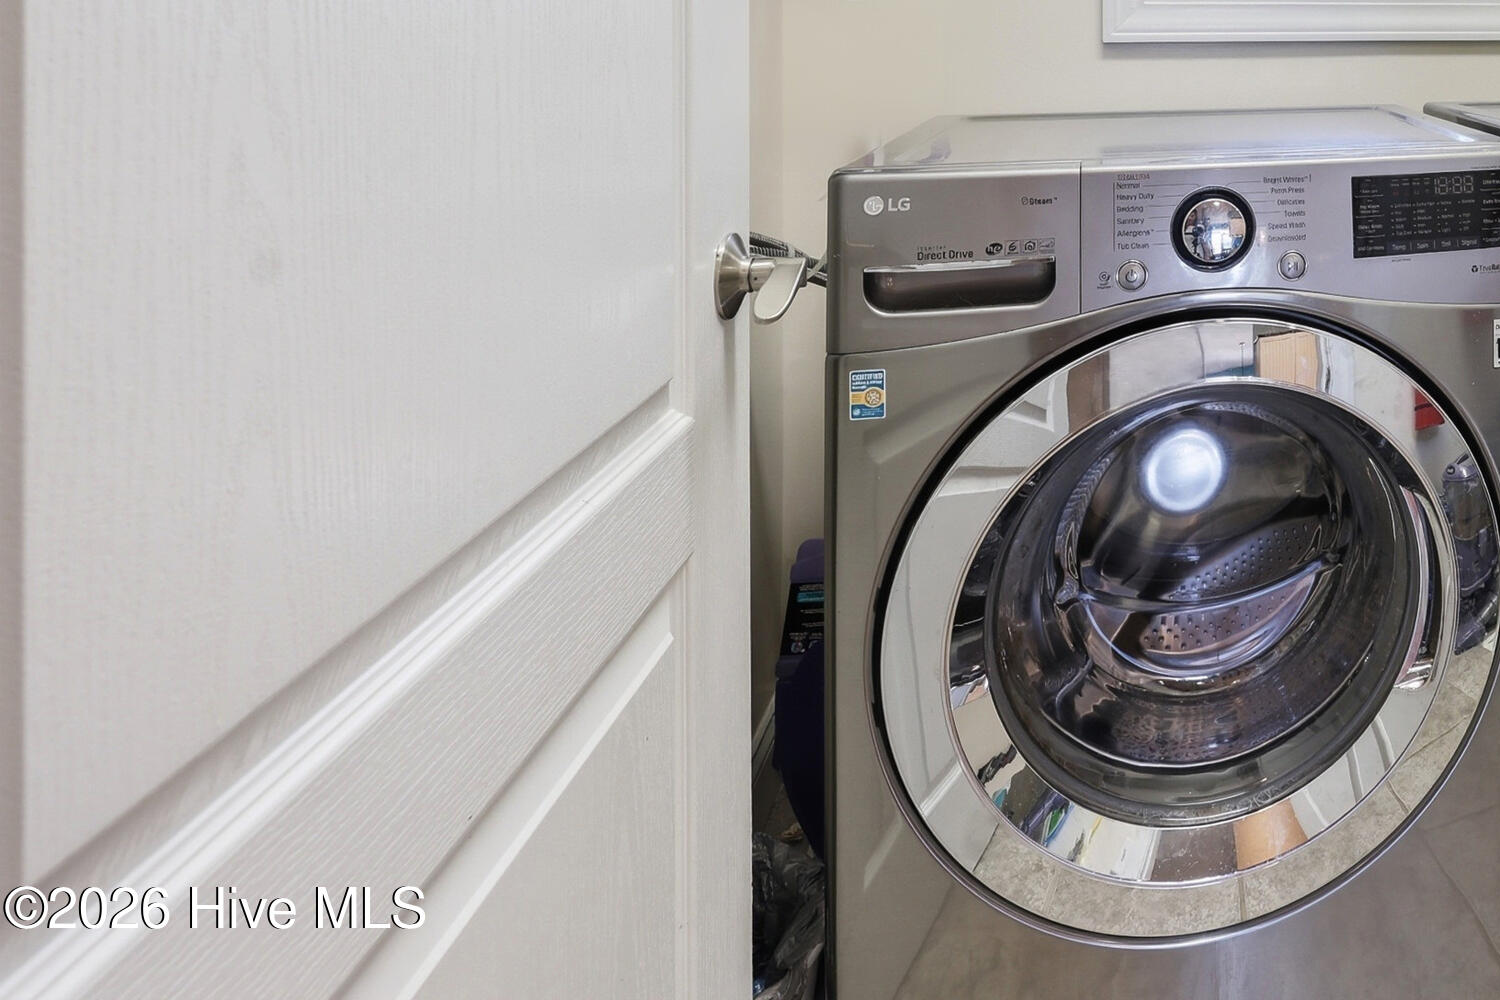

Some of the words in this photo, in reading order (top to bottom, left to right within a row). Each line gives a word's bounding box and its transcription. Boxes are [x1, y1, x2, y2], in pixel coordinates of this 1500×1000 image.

[887, 197, 911, 212] LG
[916, 251, 947, 261] Direct
[949, 250, 974, 259] Drive
